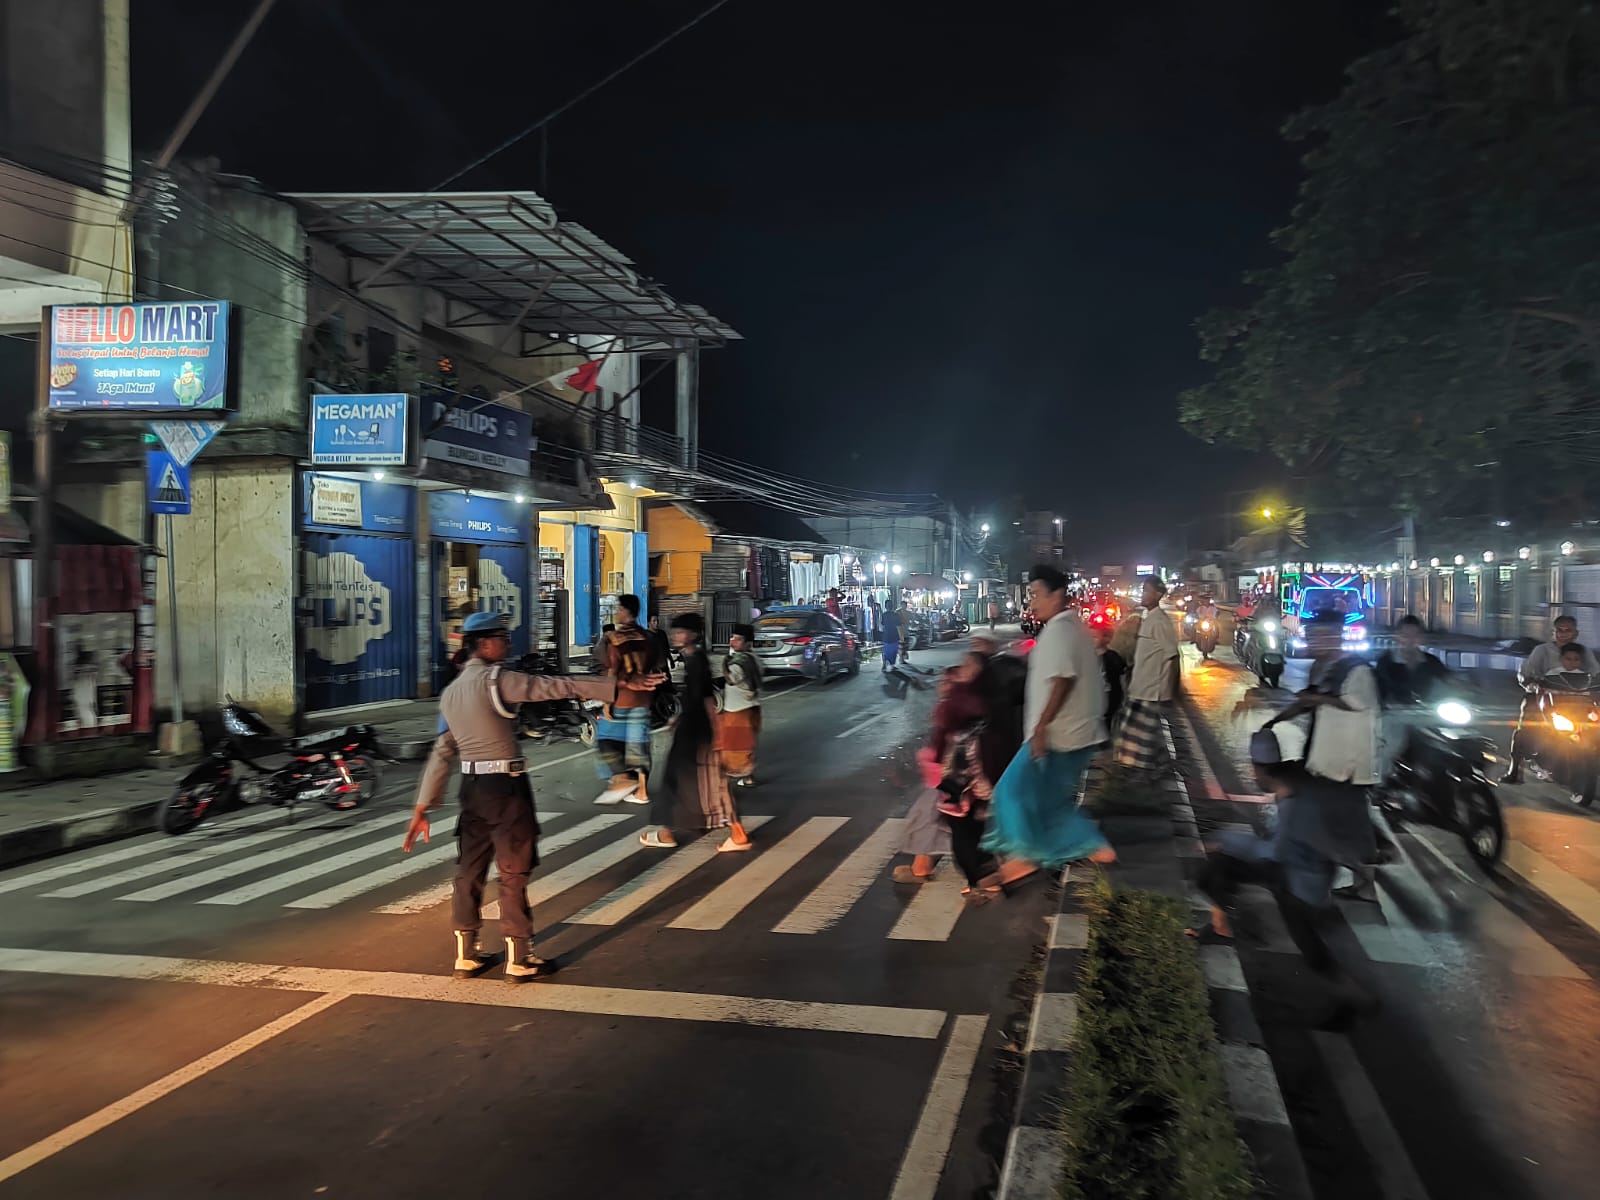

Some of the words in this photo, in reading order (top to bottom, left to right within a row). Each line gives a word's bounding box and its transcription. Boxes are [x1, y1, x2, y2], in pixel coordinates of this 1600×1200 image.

[56, 307, 136, 343] HELLO
[140, 303, 219, 342] MART
[93, 368, 118, 378] Setiap
[119, 368, 136, 377] Hari
[317, 403, 396, 419] MEGAMAN
[468, 521, 492, 532] PHILIPS
